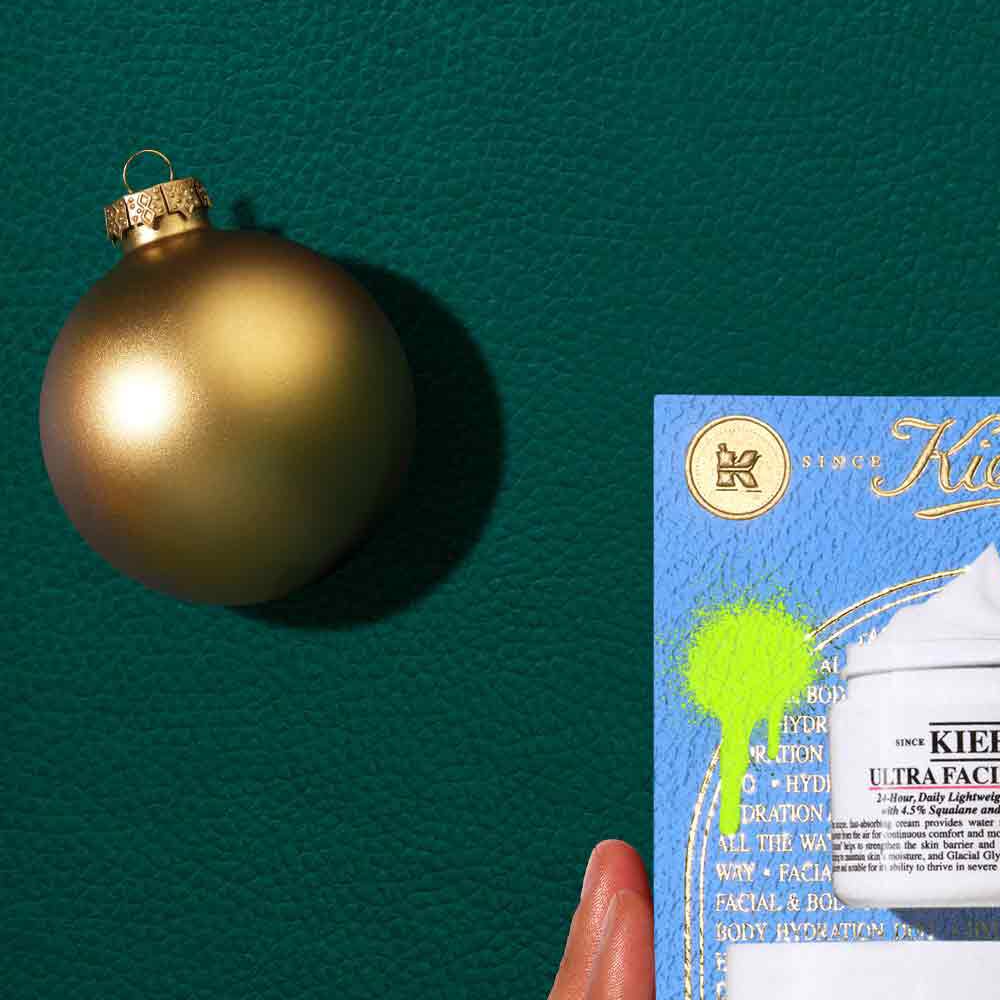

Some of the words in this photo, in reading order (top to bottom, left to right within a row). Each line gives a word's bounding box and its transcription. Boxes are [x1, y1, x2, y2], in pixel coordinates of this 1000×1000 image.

[802, 455, 881, 469] SINCE
[895, 739, 925, 747] SINCE
[869, 767, 937, 786] ULTRA
[918, 792, 945, 805] Daily
[901, 805, 926, 815] 4.5%
[929, 805, 977, 818] Squalane
[981, 804, 1000, 815] and
[895, 820, 920, 828] cream
[925, 818, 963, 830] provides
[968, 819, 994, 828] water
[928, 829, 964, 839] comfort
[967, 829, 984, 838] and
[757, 833, 793, 852] THE
[904, 841, 917, 850] the
[921, 841, 943, 850] skin
[943, 840, 974, 850] barrier
[978, 840, 995, 849] and
[927, 851, 944, 860] and
[946, 850, 980, 860] Glacial
[715, 863, 756, 882] WAY
[916, 863, 925, 872] to
[927, 862, 953, 872] thrive
[955, 862, 965, 871] in
[967, 863, 997, 871] severe
[715, 893, 784, 912] FACIAL
[787, 894, 801, 912] &
[715, 921, 768, 942] BODY
[775, 921, 886, 942] HYDRATION
